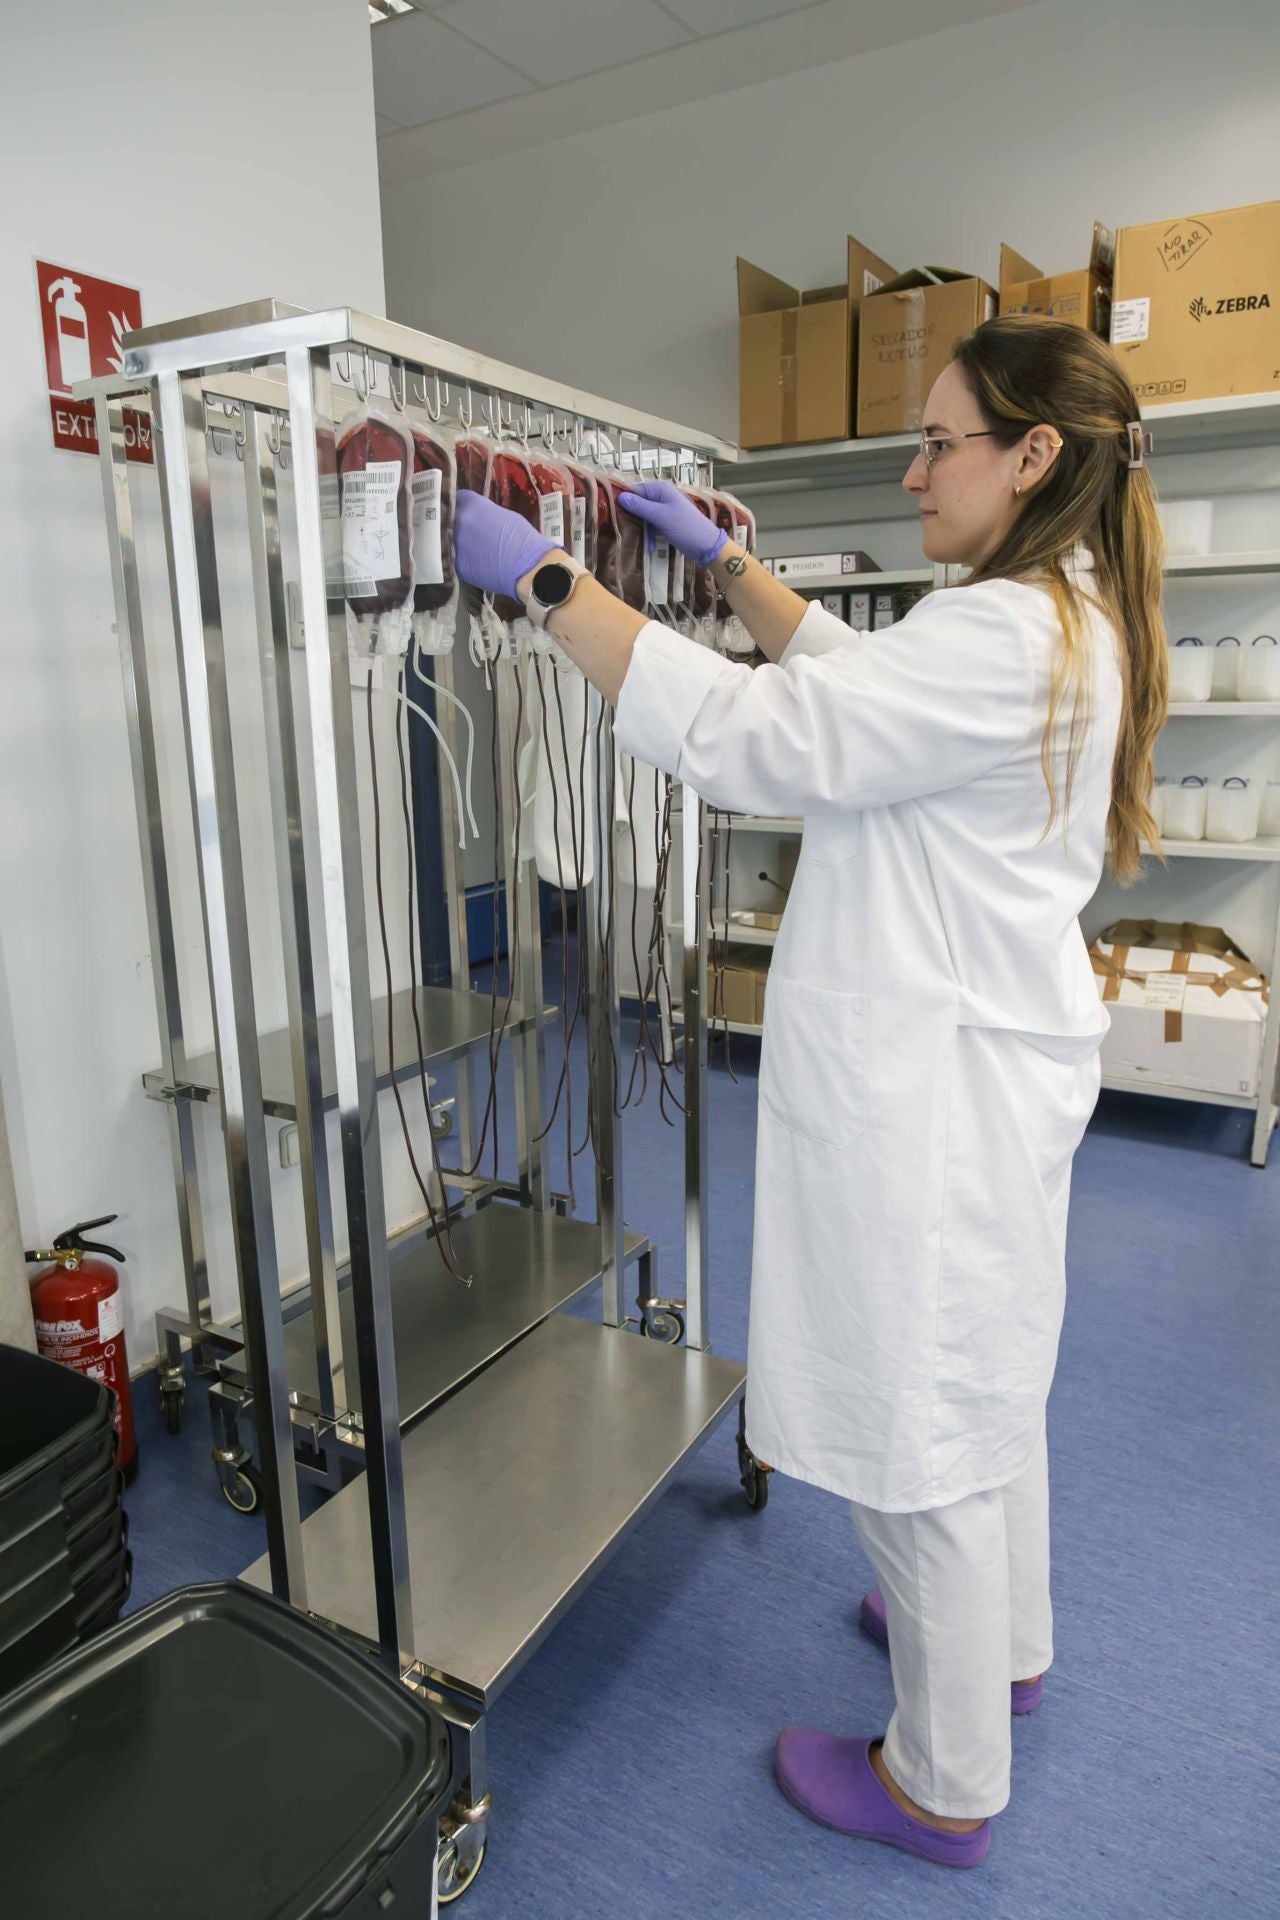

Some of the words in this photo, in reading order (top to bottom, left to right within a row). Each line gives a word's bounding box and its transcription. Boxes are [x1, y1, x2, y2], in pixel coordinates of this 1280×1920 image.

[1163, 235, 1182, 253] NO
[1168, 231, 1202, 262] TIRAR
[1215, 294, 1271, 315] ZEBRA
[55, 410, 150, 450] EXTIOR
